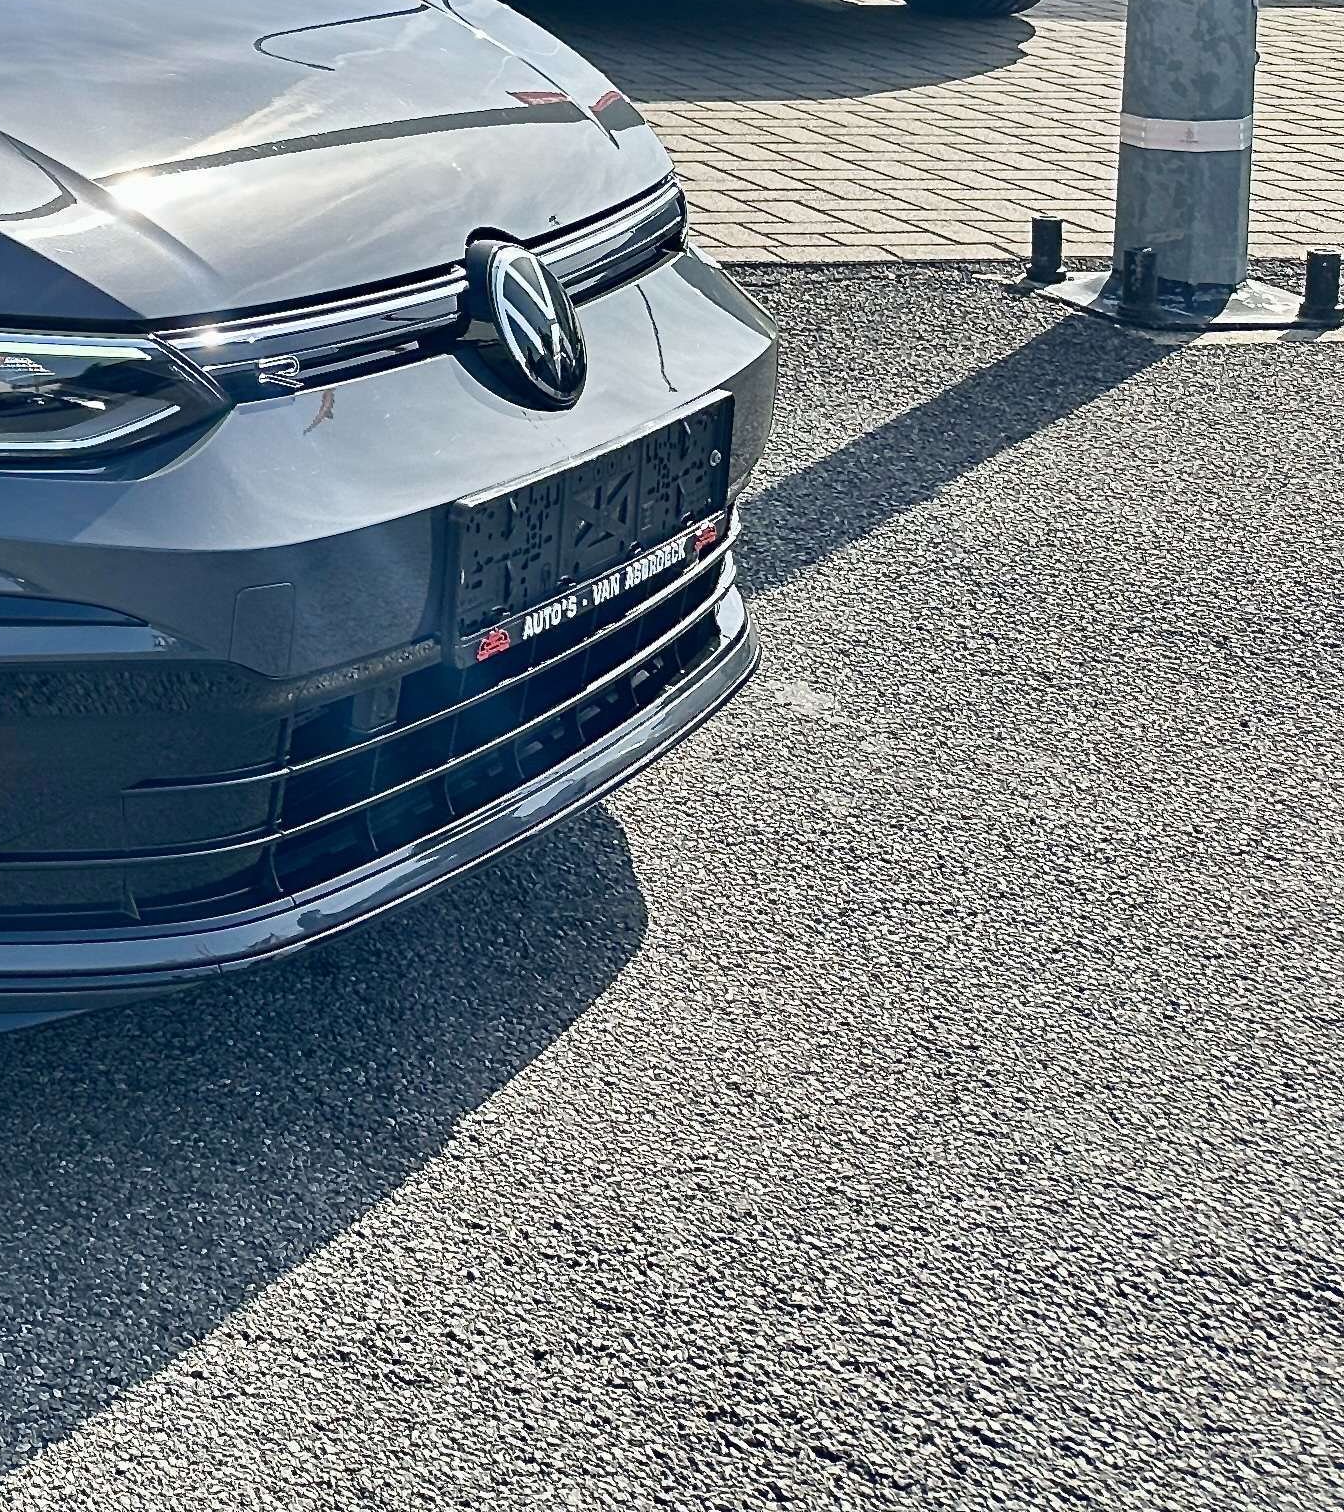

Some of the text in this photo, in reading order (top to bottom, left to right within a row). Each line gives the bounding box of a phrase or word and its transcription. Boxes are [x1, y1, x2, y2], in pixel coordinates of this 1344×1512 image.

[258, 354, 305, 388] R
[522, 595, 578, 640] AUTO'S
[591, 572, 621, 606] VAN
